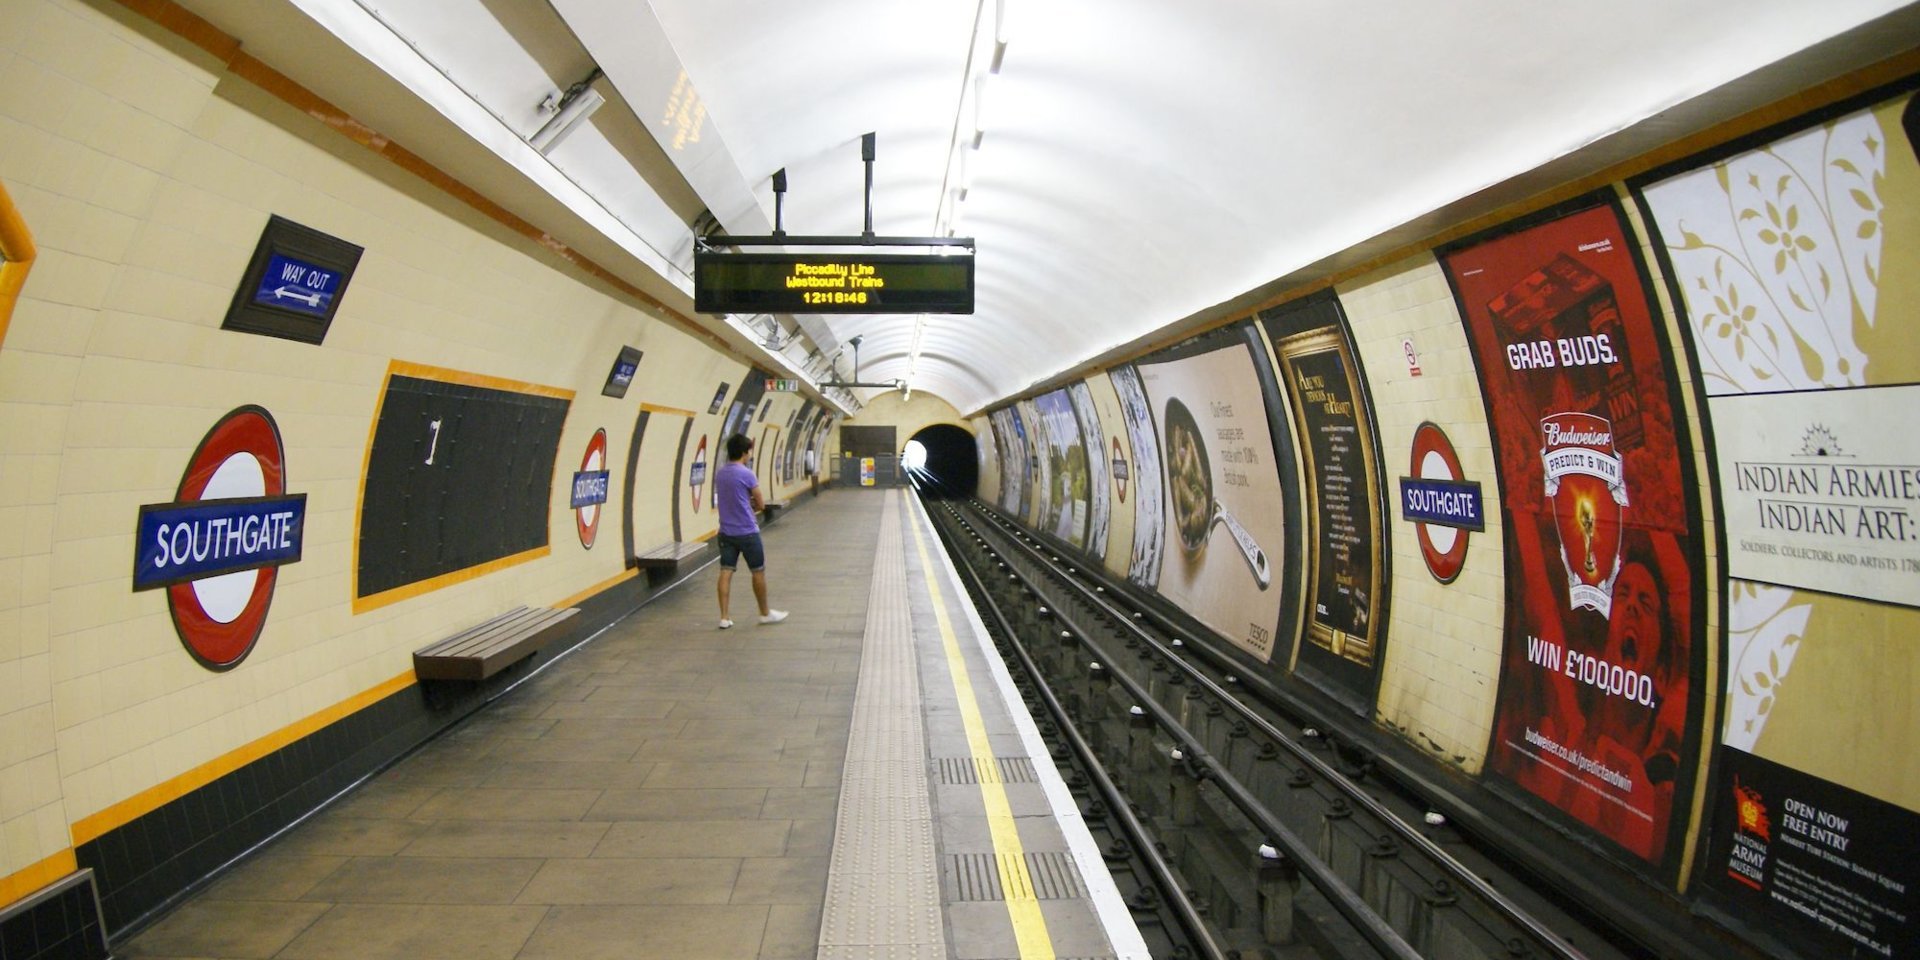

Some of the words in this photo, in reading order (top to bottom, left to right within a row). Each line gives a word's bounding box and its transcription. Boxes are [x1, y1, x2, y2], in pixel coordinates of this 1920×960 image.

[281, 262, 305, 283] WAY
[307, 270, 330, 291] OUT
[786, 276, 845, 288] Westbound
[848, 276, 884, 288] Trains
[795, 263, 848, 276] Piccadilly
[851, 263, 875, 275] Line
[1506, 341, 1556, 371] GRAB
[1558, 333, 1618, 368] BUDS.
[1544, 422, 1611, 446] Budweiser
[1548, 453, 1585, 472] PREDICT
[1588, 456, 1595, 468] &
[1596, 458, 1616, 479] WIN
[1734, 462, 1819, 495] INDIAN
[575, 478, 607, 499] SOUTHGATE
[1408, 488, 1475, 518] SOUTHGATE
[1758, 499, 1846, 536] INDIAN
[1856, 505, 1916, 541] ART:
[154, 511, 293, 569] SOUTHGATE
[1781, 546, 1834, 563] COLLECTORS
[1836, 553, 1858, 567] AND
[1860, 556, 1898, 571] ARTISTS
[1249, 623, 1269, 644] TESCO
[1527, 635, 1561, 672] WIN
[1565, 650, 1655, 708] £100,000.
[1785, 798, 1815, 819] OPEN
[1817, 810, 1848, 832] NOW
[1733, 832, 1767, 854] NATIONAL
[1782, 813, 1808, 834] FREE
[1810, 825, 1849, 852] ENTRY
[1731, 844, 1766, 869] ARMY
[1729, 859, 1764, 882] MUSEUM
[1878, 873, 1906, 894] SQUARE
